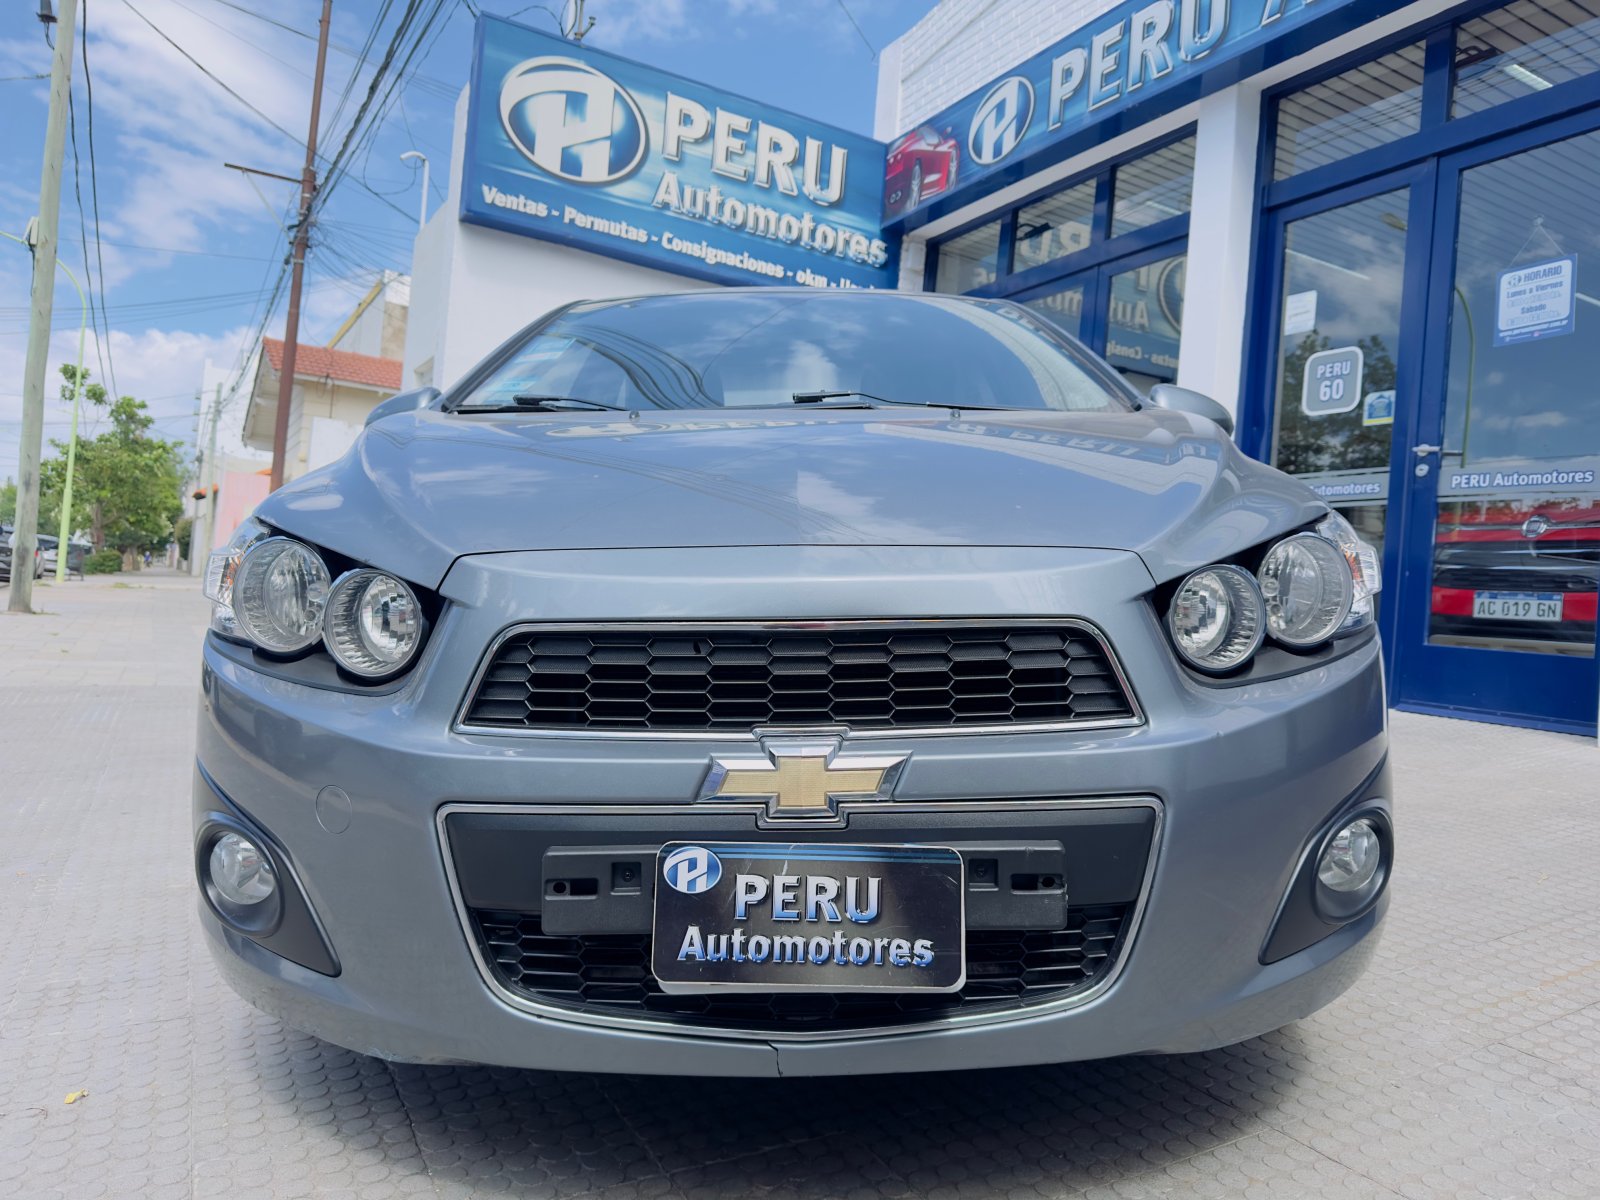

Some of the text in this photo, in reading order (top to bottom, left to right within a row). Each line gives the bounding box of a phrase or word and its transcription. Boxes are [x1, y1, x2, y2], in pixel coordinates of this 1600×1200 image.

[1047, 0, 1232, 132] PERU
[662, 92, 848, 206] PERU
[481, 183, 549, 218] Ventas
[563, 204, 649, 245] Permutas
[661, 231, 784, 277] Consignaciones
[651, 170, 888, 268] Automotores
[1524, 265, 1562, 281] HORARIO
[1316, 361, 1351, 379] PERU
[1319, 378, 1344, 401] 60
[1451, 470, 1594, 488] PERU Automotores
[1477, 601, 1557, 618] AC 019 GN
[733, 873, 882, 924] PERU
[676, 924, 935, 967] Automotores
